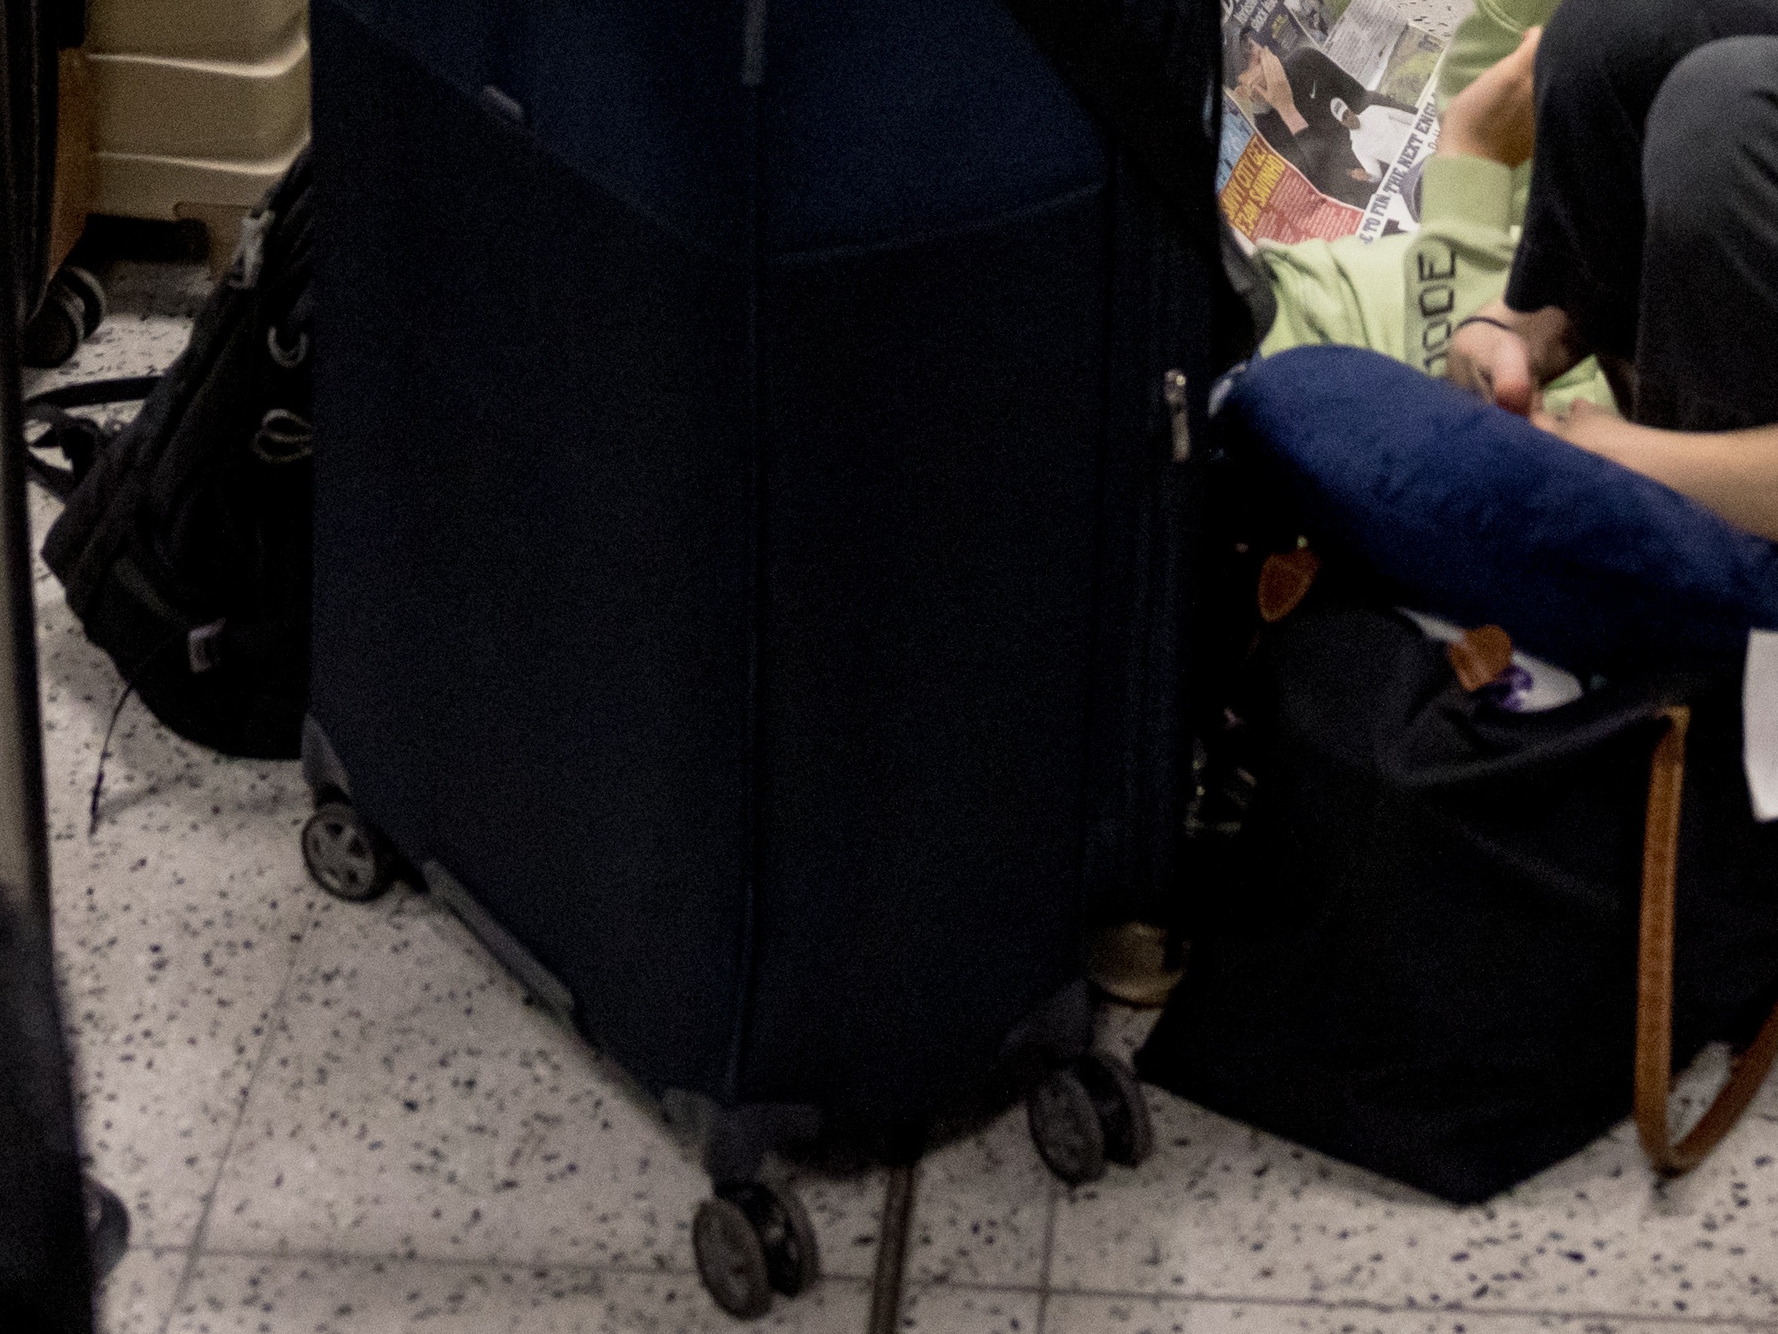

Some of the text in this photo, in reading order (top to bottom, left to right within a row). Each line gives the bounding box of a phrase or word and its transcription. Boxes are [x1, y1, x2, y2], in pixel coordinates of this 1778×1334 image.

[1232, 156, 1257, 189] CITY
[1243, 134, 1269, 167] GET
[1382, 165, 1406, 194] THE
[1396, 132, 1424, 169] NEXT
[1247, 153, 1287, 208] SAVINHO
